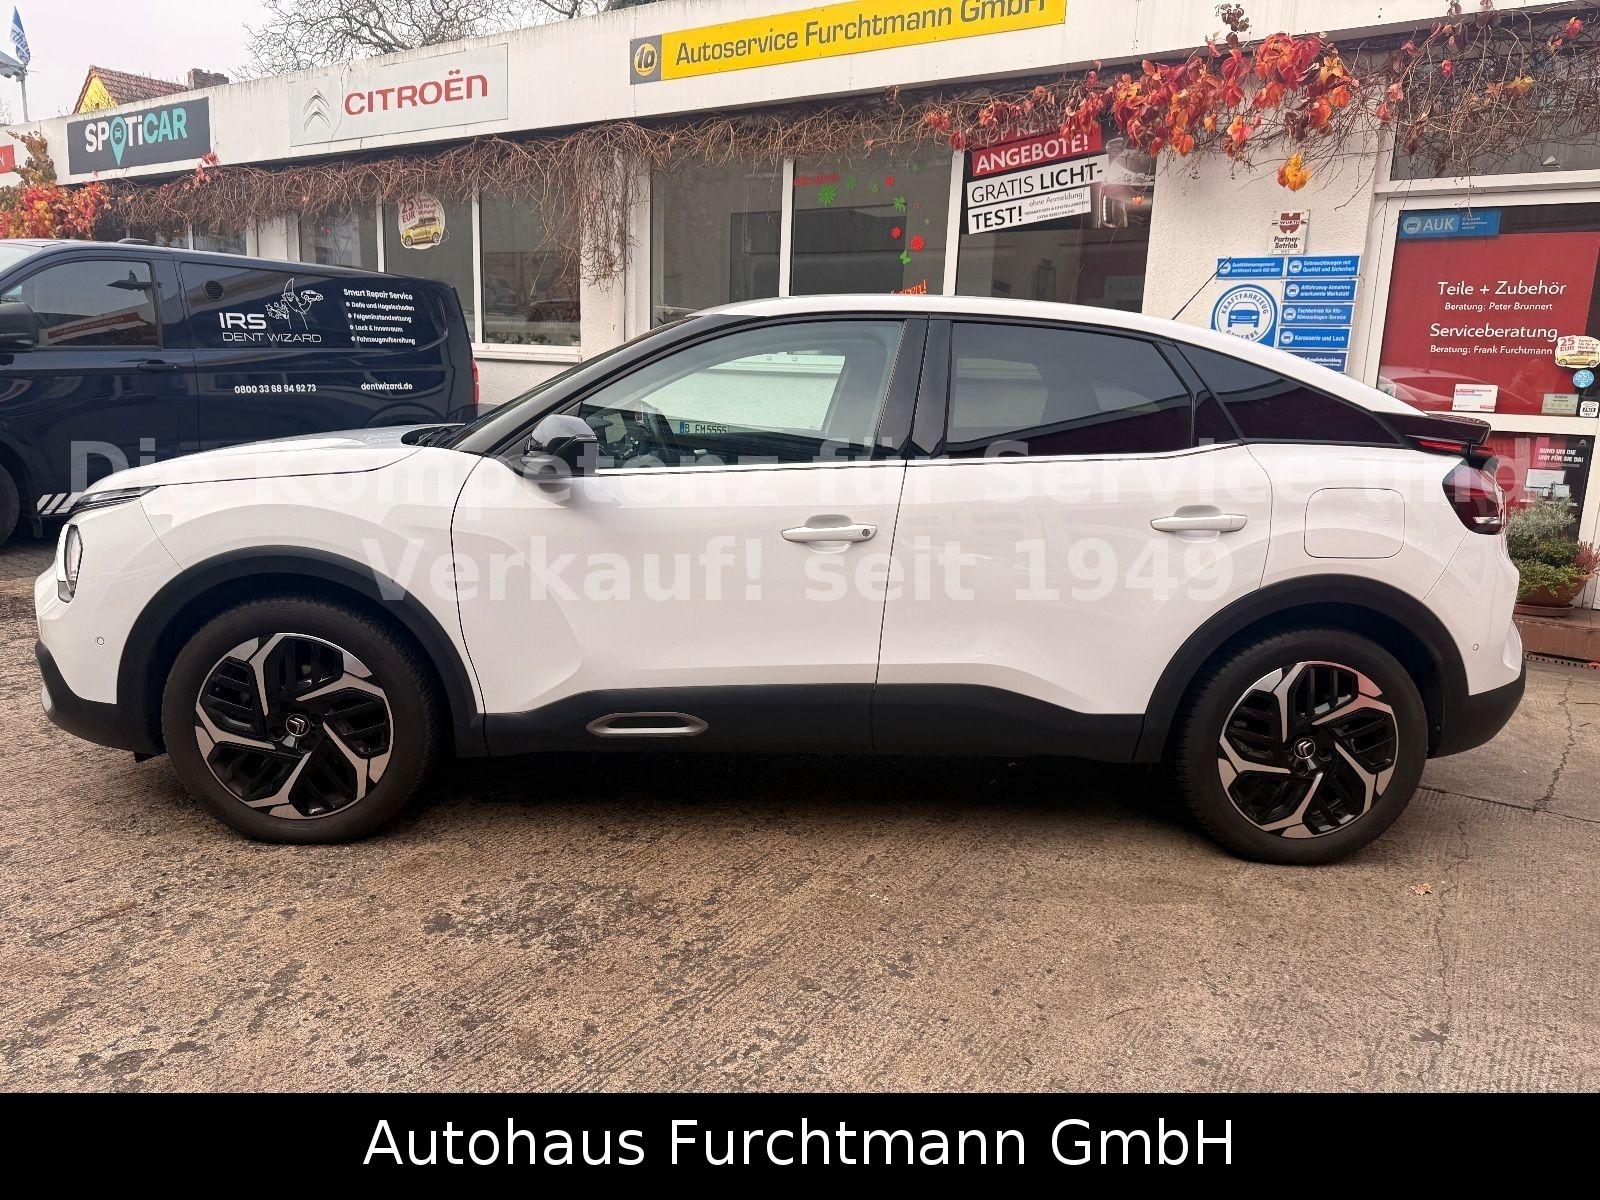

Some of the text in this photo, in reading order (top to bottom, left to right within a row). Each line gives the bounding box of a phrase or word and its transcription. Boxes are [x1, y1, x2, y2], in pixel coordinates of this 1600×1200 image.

[676, 29, 798, 65] Autoservice
[805, 6, 952, 46] Furchtmann
[976, 134, 1089, 173] ANGEBOTE!
[971, 162, 1103, 203] GRATIS LICHT-
[1046, 192, 1083, 204] Anmeldung
[402, 211, 416, 223] EUR
[972, 205, 1022, 230] TEST!
[1423, 218, 1455, 231] AUK
[1438, 280, 1566, 295] Teile + Zubehör
[343, 288, 413, 300] Smart Repair Service
[1221, 293, 1268, 314] KRAFTFAHRZEUG
[1445, 302, 1552, 312] Beratung: Peter Brunnert
[219, 312, 267, 329] IRS
[222, 332, 322, 343] DENT WIZARD
[1430, 323, 1558, 342] Serviceberatung
[1560, 337, 1575, 347] 25
[1430, 345, 1552, 355] Beratung: Frank Furchtmann
[234, 385, 257, 394] 0800
[259, 384, 269, 393] 33
[271, 384, 282, 393] 68
[283, 384, 295, 393] 94
[361, 381, 413, 391] dentwizard.de
